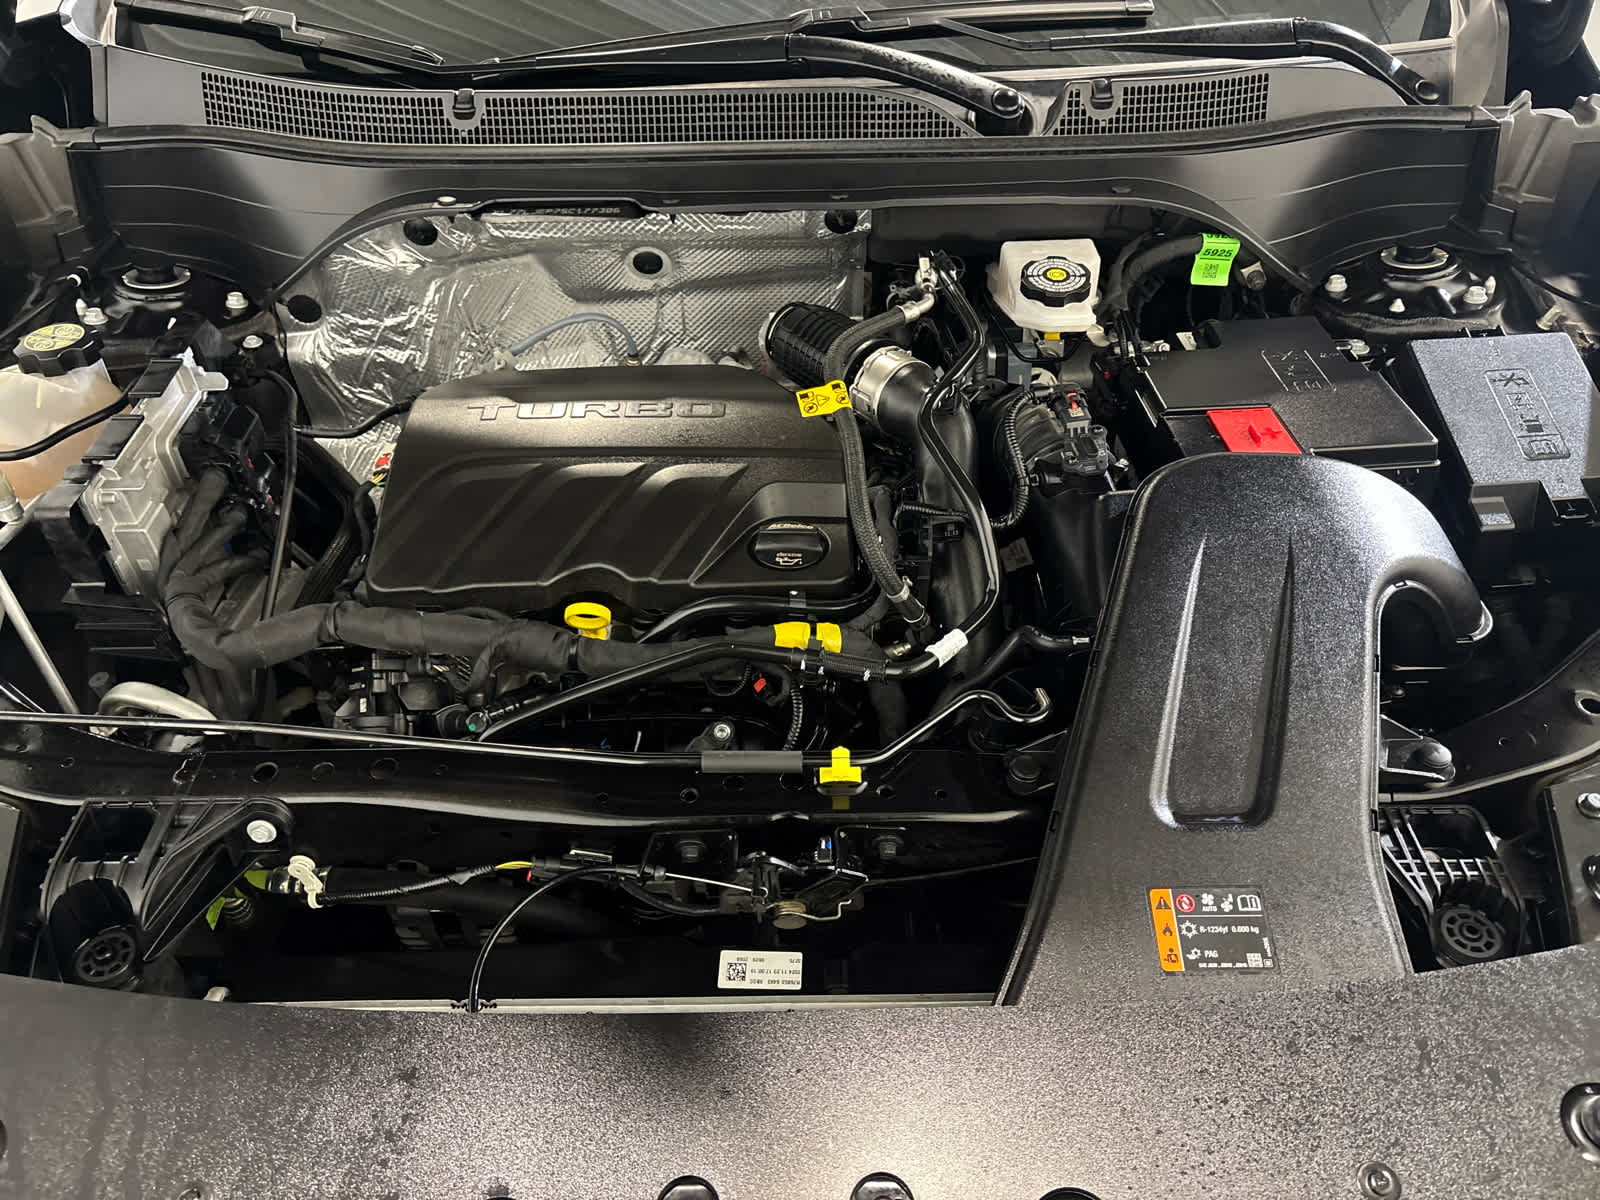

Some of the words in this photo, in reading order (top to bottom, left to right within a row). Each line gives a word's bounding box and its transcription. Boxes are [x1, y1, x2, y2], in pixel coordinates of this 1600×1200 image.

[1203, 248, 1233, 257] 5925
[467, 401, 726, 421] TURBO
[1251, 925, 1260, 934] kg
[1204, 950, 1219, 958] PAG
